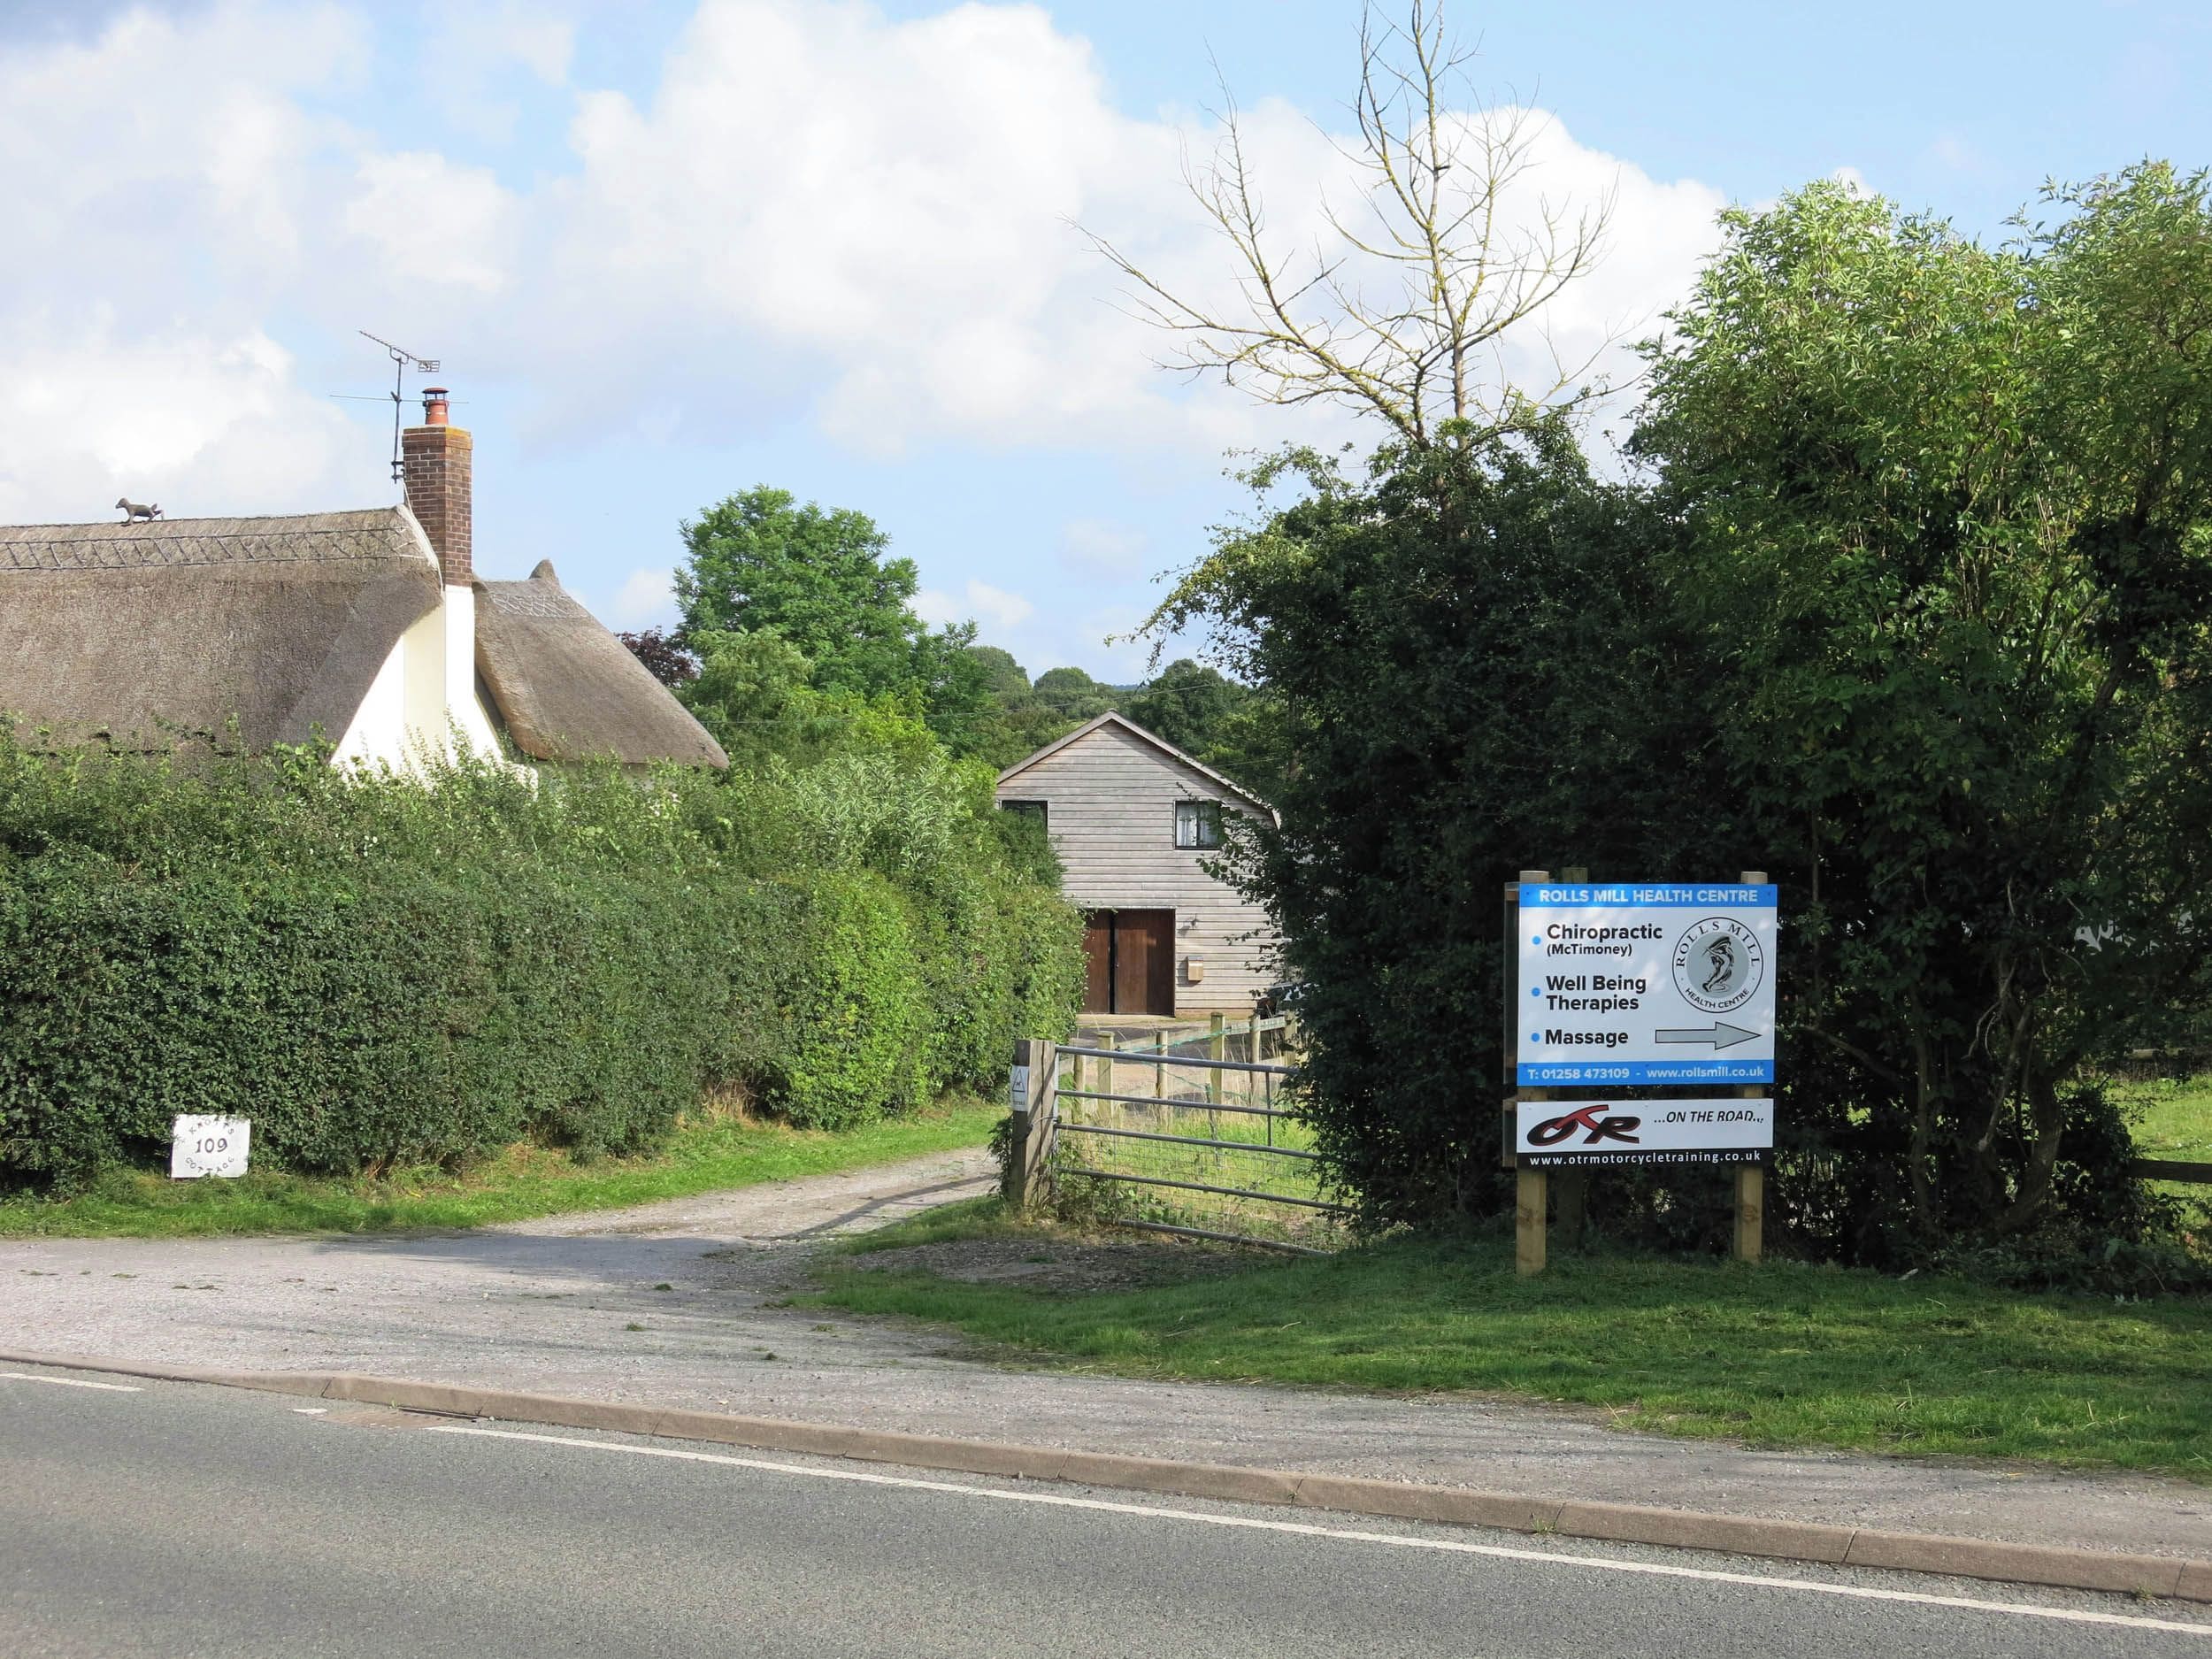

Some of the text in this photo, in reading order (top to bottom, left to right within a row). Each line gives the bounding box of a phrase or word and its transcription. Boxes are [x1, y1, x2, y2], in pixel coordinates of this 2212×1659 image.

[1540, 889, 1758, 902] ROLLS MILL HEALTH CENTRE
[1547, 923, 1663, 942] Chiropractic
[1547, 943, 1632, 956] (McTimoney)
[1677, 921, 1760, 967] ROLLS MILL
[1546, 975, 1647, 994] Well Being
[1546, 995, 1639, 1014] Therapies
[1685, 987, 1749, 1009] HEALTH CENTRE
[1545, 1029, 1629, 1048] Massage
[1541, 1068, 1581, 1079] 01258
[1584, 1067, 1630, 1079] 473109
[1647, 1066, 1764, 1078] www.rollsmill.co.uk
[1691, 1110, 1714, 1123] THE
[195, 1137, 228, 1154] 109
[1530, 1150, 1762, 1167] www.otrmotorcycletraining.co.uk
